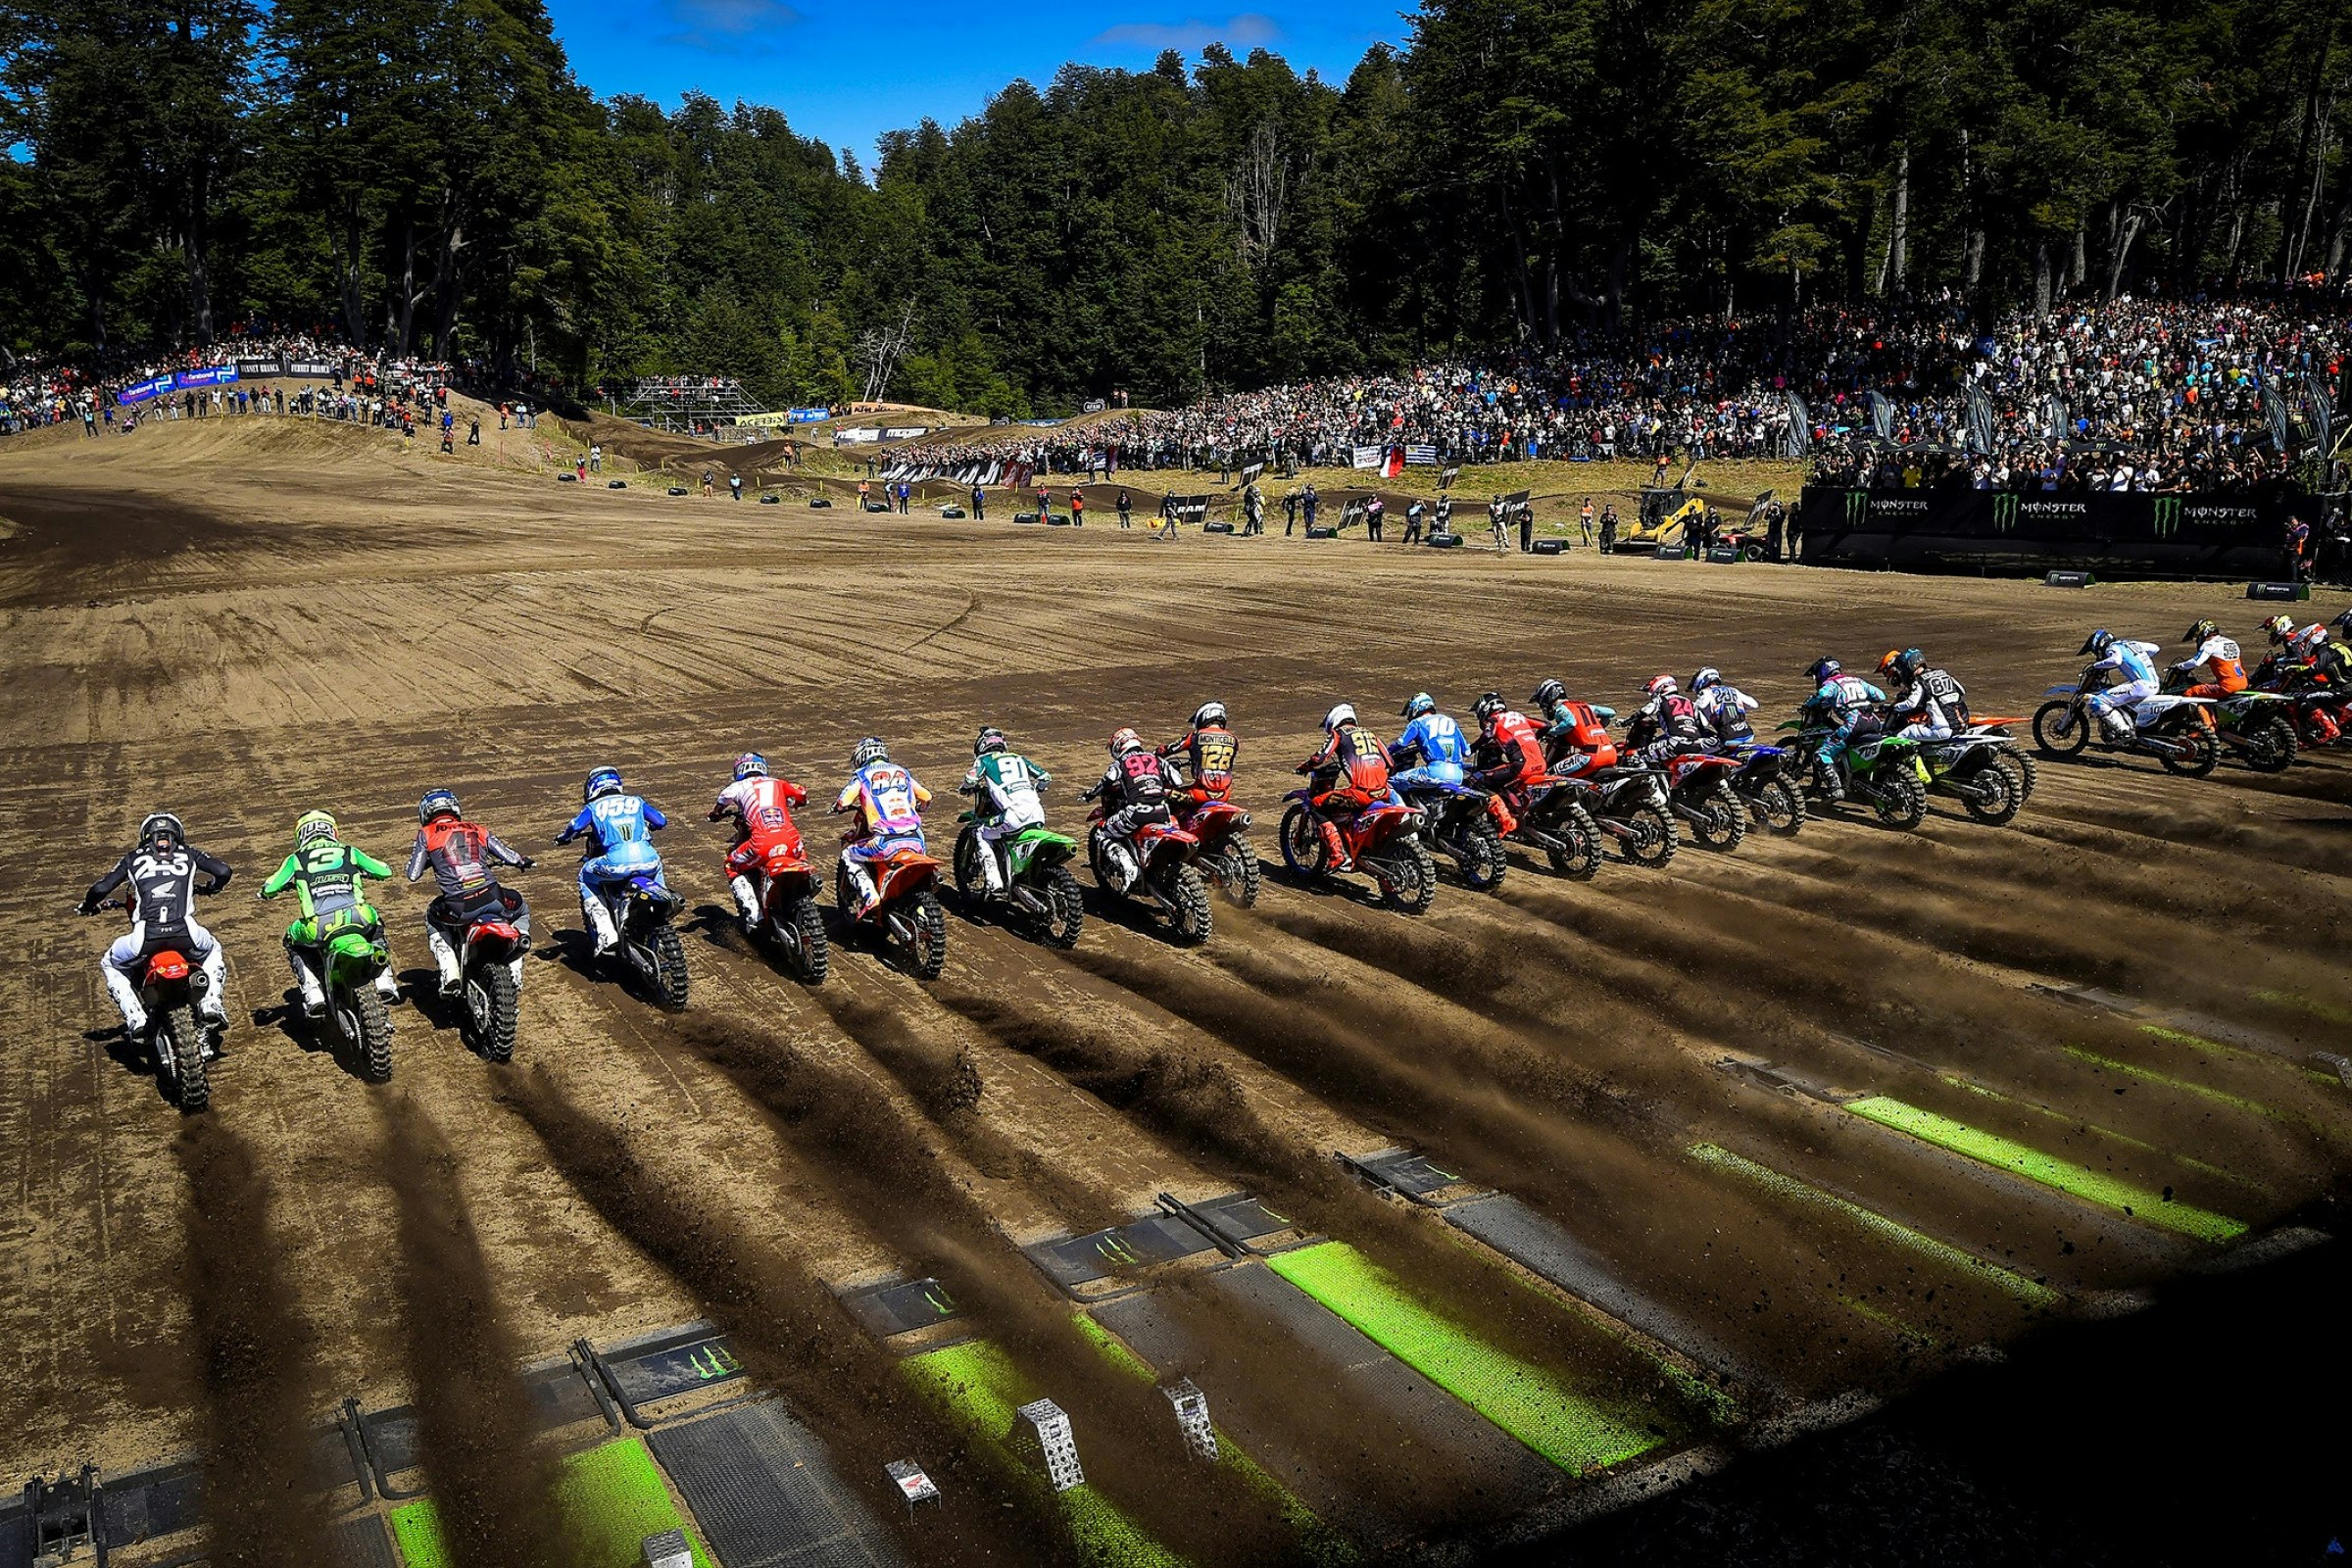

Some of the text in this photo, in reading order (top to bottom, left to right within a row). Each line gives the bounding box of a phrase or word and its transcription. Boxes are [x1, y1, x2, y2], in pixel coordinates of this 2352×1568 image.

[740, 416, 783, 428] ACERBIS
[1177, 505, 1206, 514] RAM
[1870, 499, 1929, 510] MONSTER
[2021, 501, 2086, 514] MONSTER
[2184, 506, 2257, 518] MONSTER
[1929, 674, 1953, 696] 87
[1668, 698, 1694, 717] 24
[1425, 717, 1456, 740] 10
[1125, 755, 1159, 777] 92
[753, 780, 775, 808] 1
[871, 770, 908, 796] 84
[595, 797, 641, 822] 959
[307, 847, 345, 873] 3
